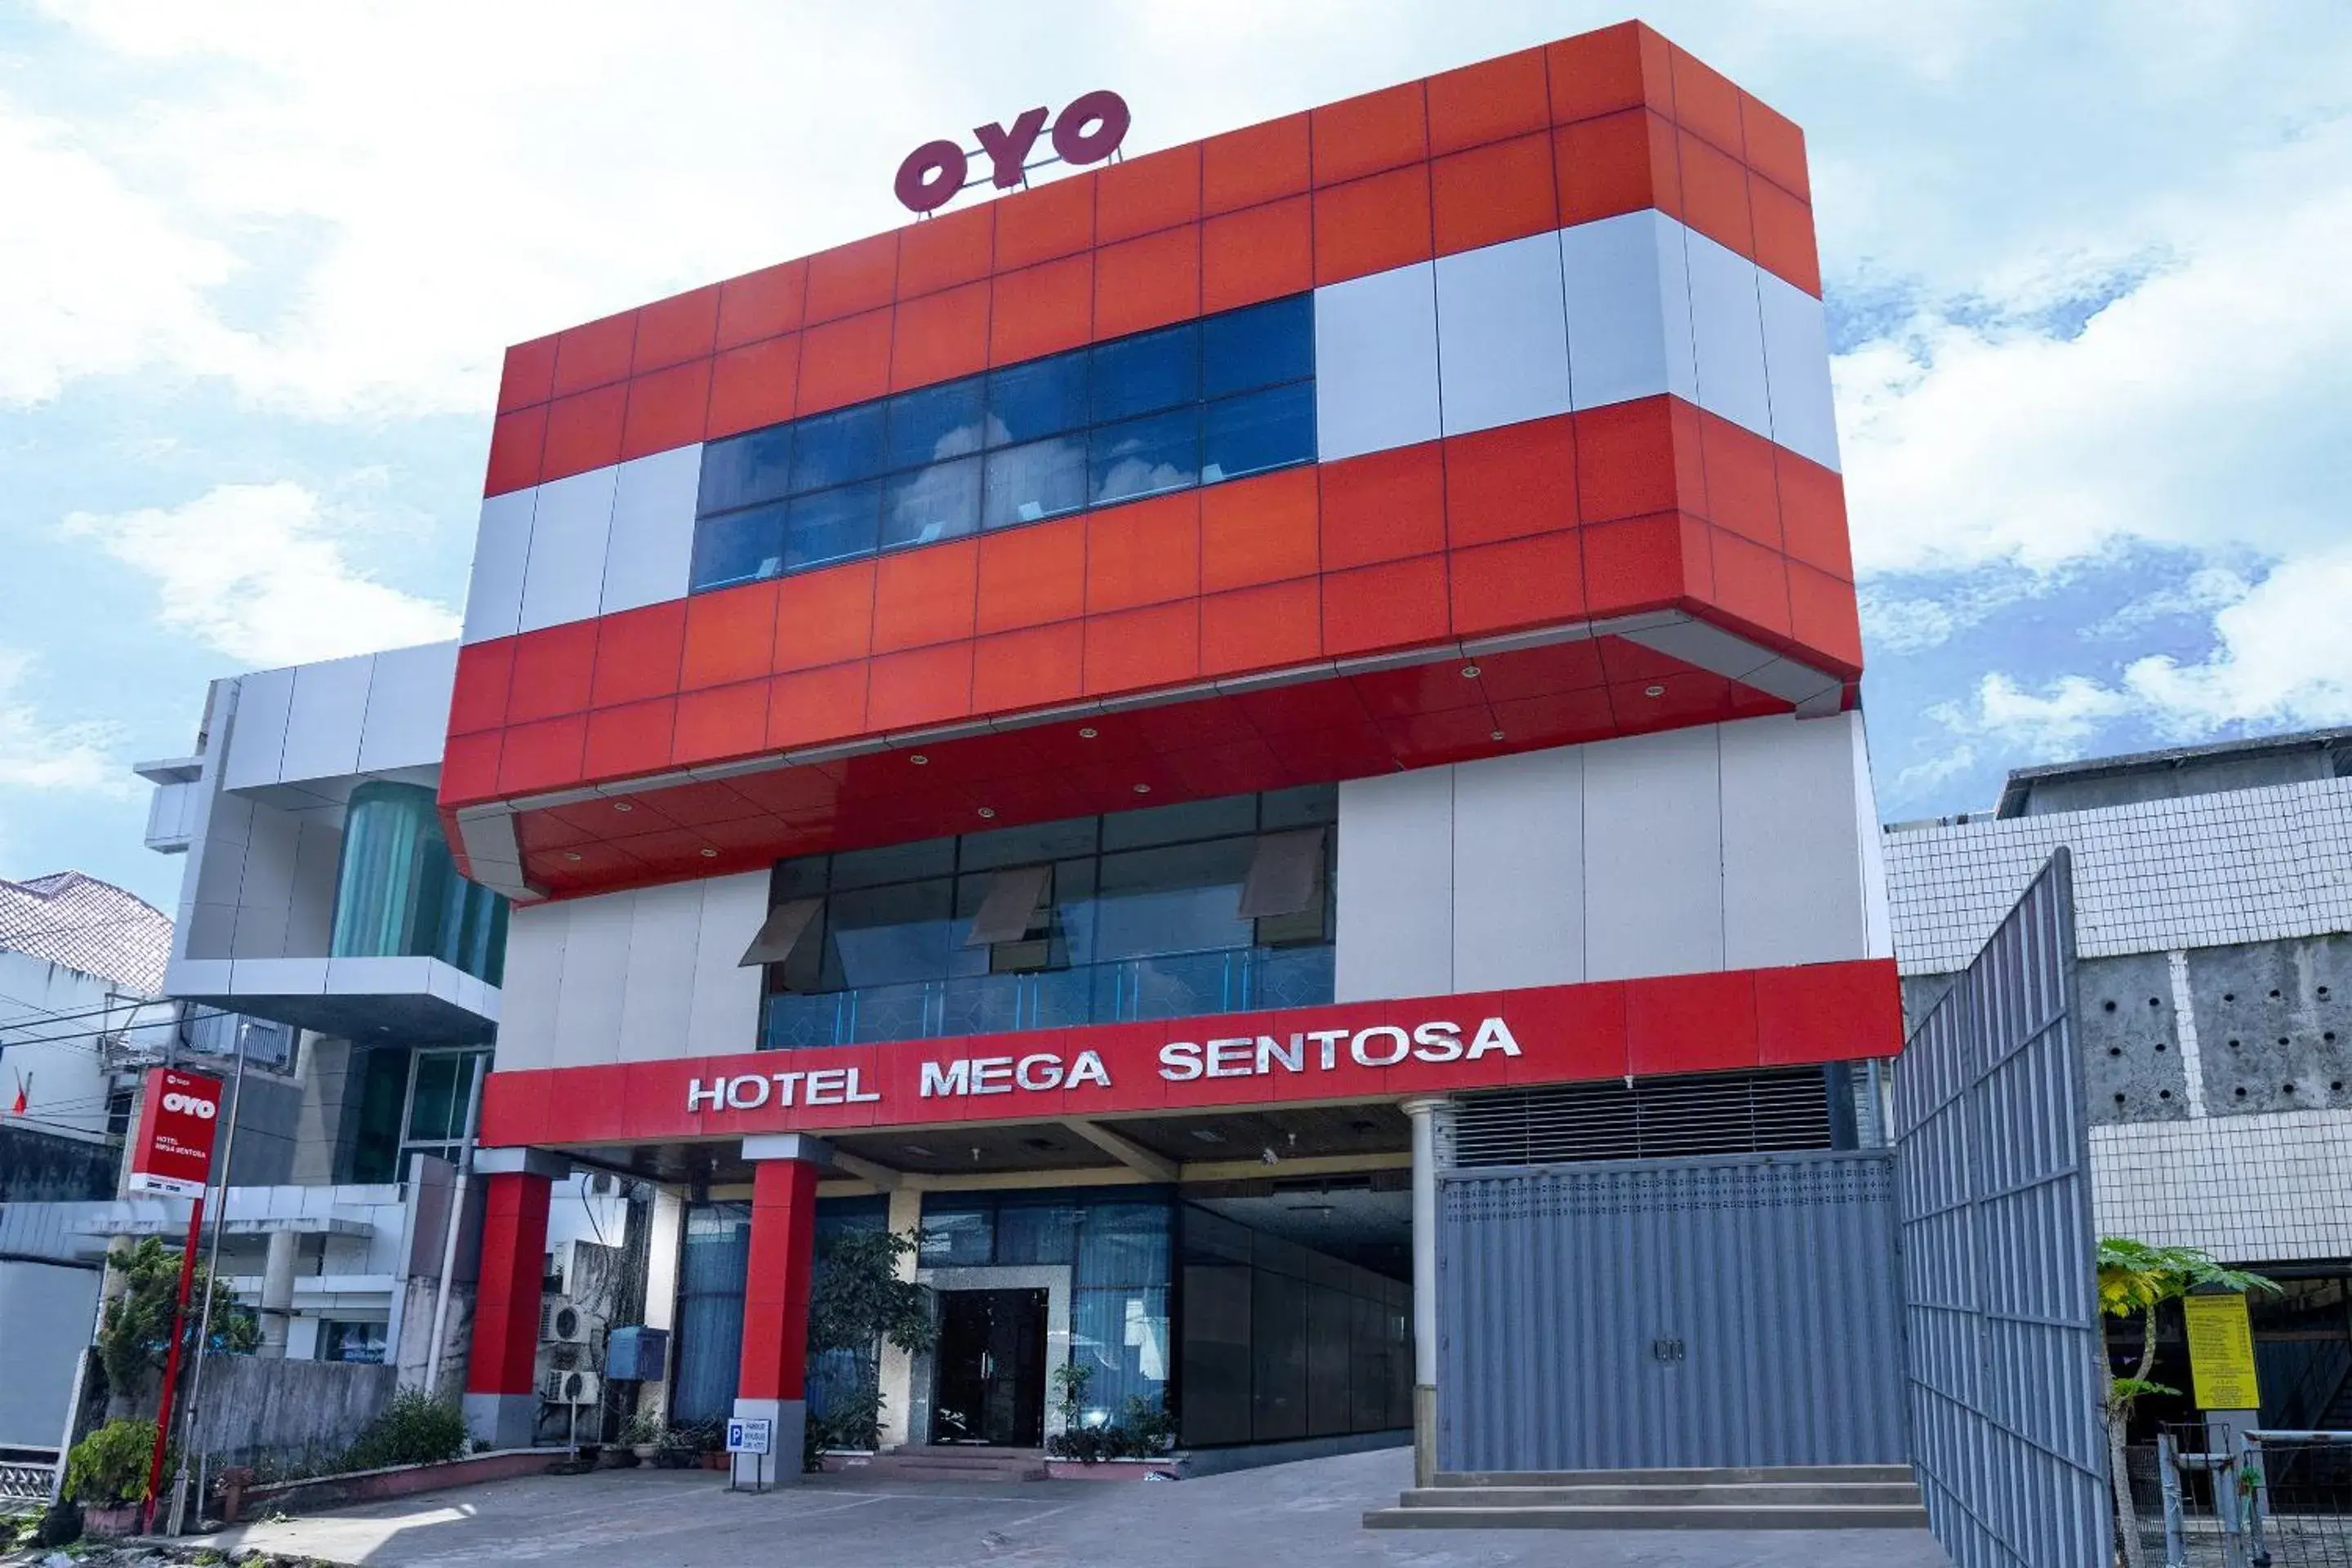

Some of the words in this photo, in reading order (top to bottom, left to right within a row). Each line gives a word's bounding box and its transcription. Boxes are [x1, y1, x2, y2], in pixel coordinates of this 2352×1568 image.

[893, 89, 1132, 212] OYO
[688, 1067, 881, 1113] HOTEL
[920, 1049, 1112, 1098] MEGA
[1158, 1016, 1522, 1081] SENTOSA
[163, 1092, 216, 1119] OYO
[156, 1135, 179, 1145] HOTEL
